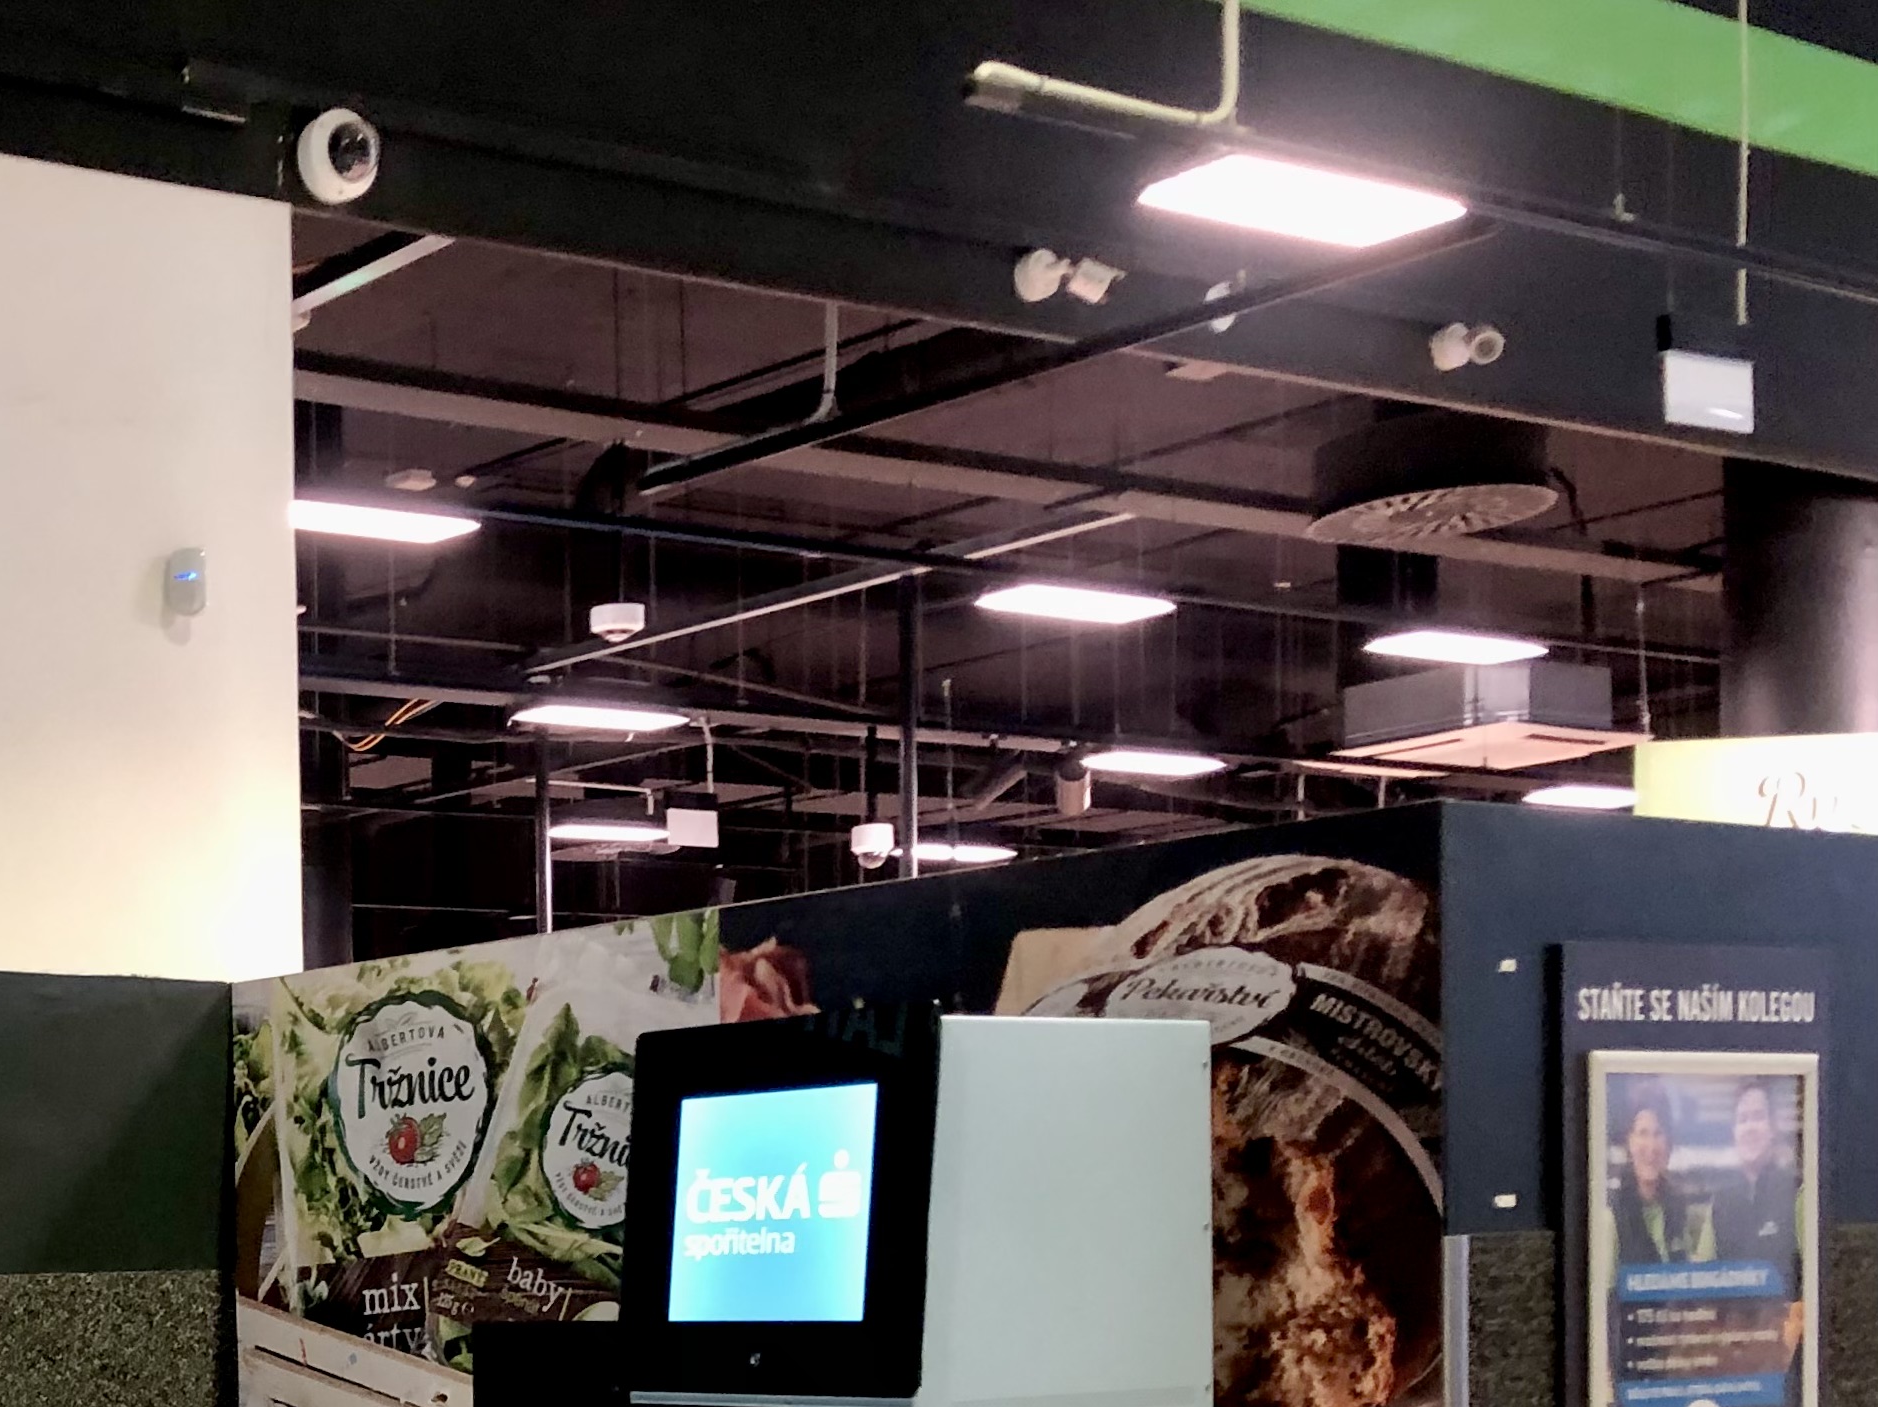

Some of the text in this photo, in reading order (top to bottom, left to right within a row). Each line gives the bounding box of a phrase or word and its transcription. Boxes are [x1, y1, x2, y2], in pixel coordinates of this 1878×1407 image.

[1578, 981, 1815, 1022] STAŇTE SE NAŠÍM KOLEGOU
[368, 1026, 445, 1052] ALBERTOVA
[345, 1053, 476, 1120] Tržnice
[686, 1161, 811, 1224] ČESKÁ
[683, 1226, 796, 1262] spořitelna
[362, 1271, 422, 1316] mix
[506, 1255, 567, 1313] baby
